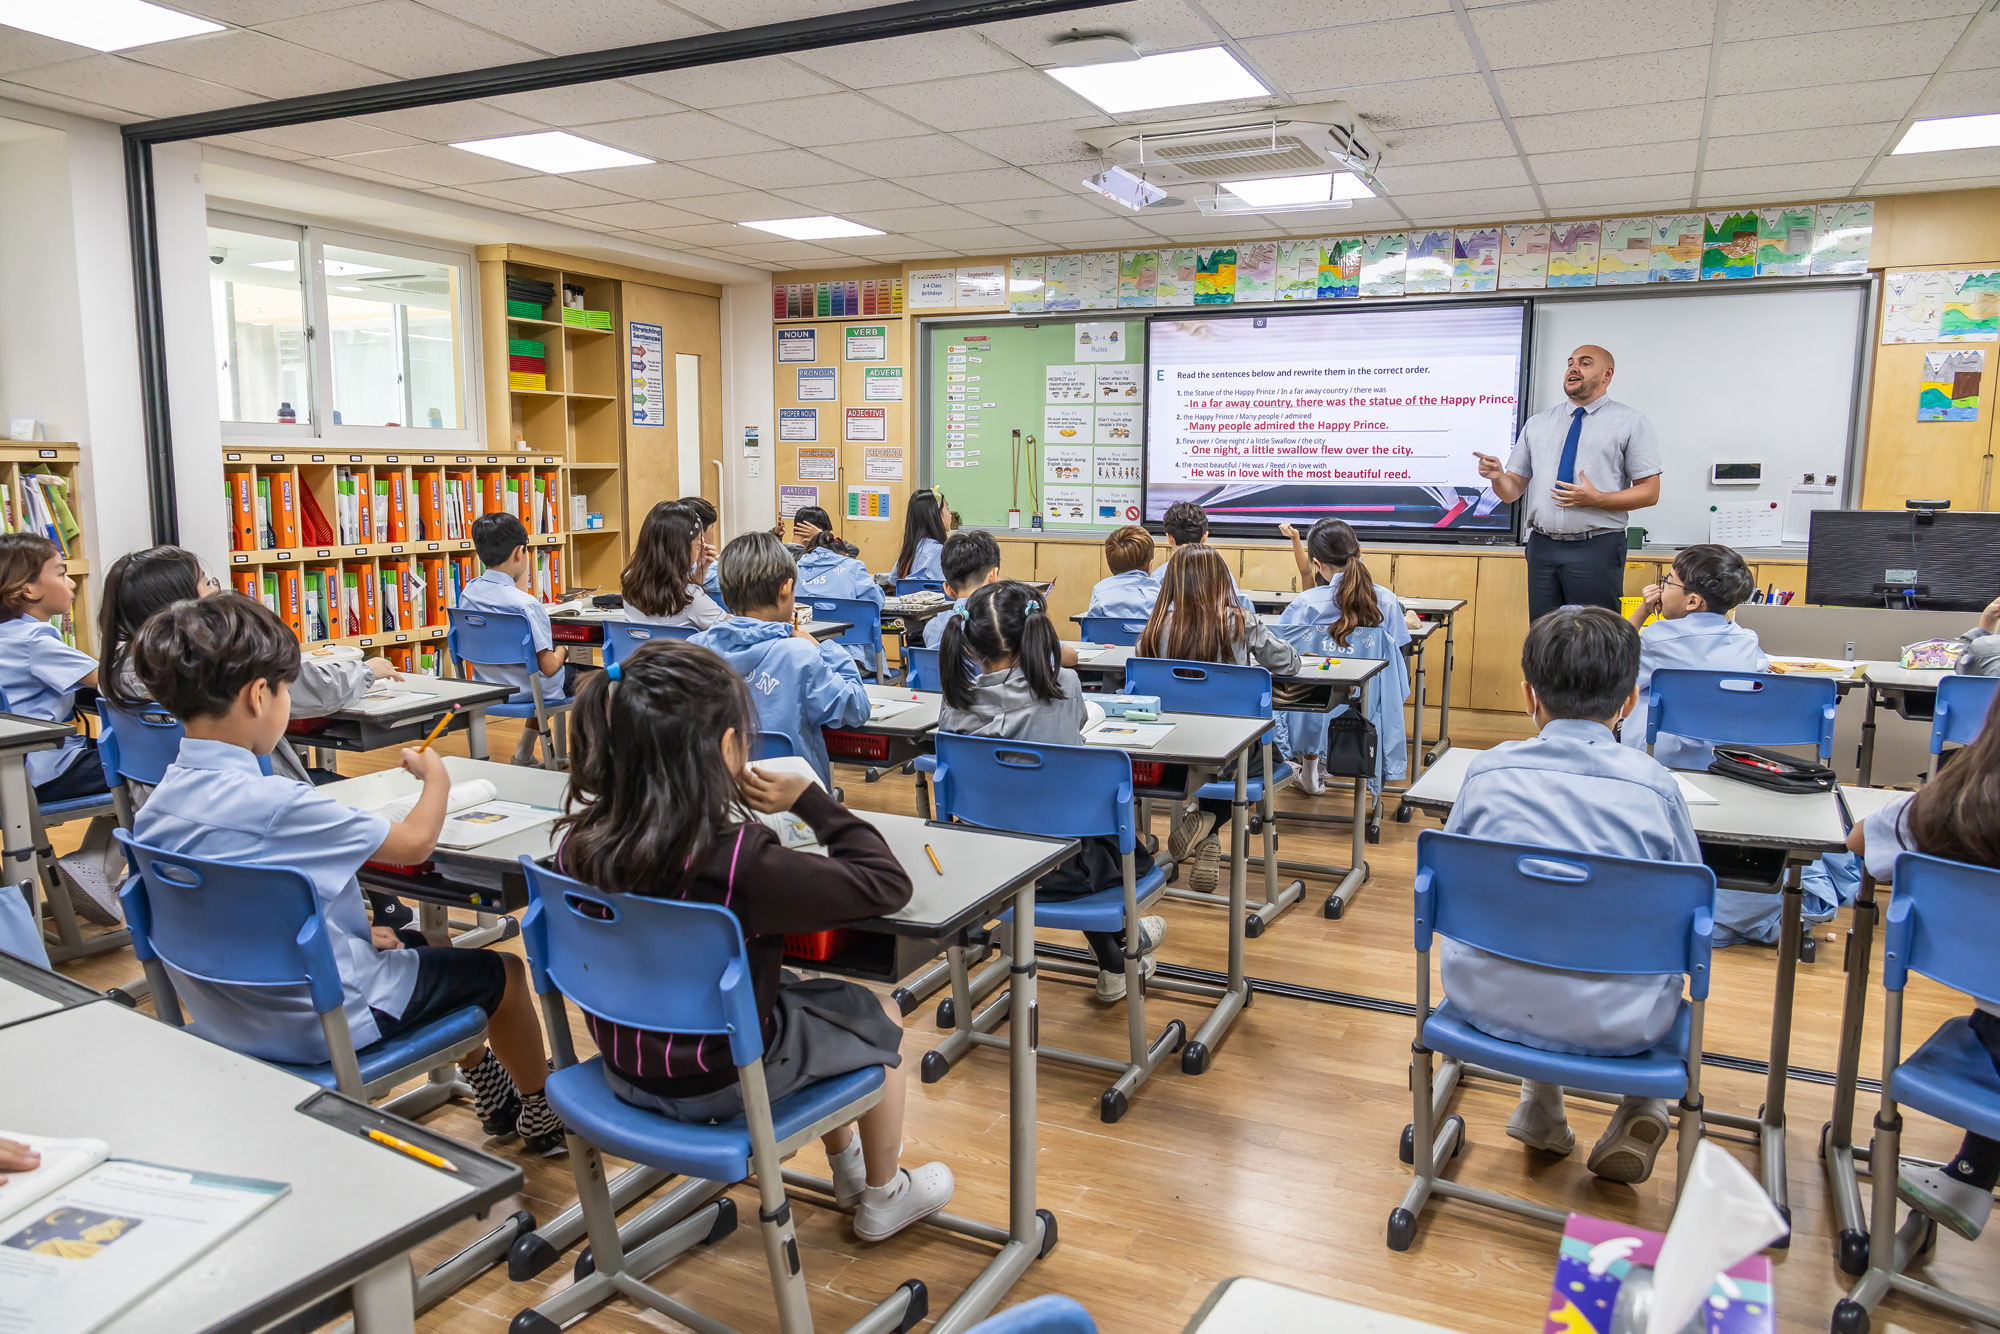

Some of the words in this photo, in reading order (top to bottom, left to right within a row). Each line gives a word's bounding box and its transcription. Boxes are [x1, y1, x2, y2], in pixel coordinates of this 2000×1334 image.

[632, 324, 660, 336] Stretching
[1157, 370, 1164, 381] E
[1210, 399, 1222, 407] far
[1225, 401, 1250, 409] away
[1253, 399, 1293, 408] country,
[1296, 398, 1323, 406] there
[1349, 397, 1366, 406] the
[1369, 397, 1402, 405] statue
[1405, 395, 1417, 405] of
[1419, 395, 1437, 405] the
[1440, 395, 1476, 406] Happy
[1479, 395, 1517, 404] Prince.
[1189, 422, 1216, 432] Many
[1219, 421, 1251, 432] people
[1254, 421, 1295, 430] admired
[1298, 421, 1314, 430] the
[1318, 421, 1350, 432] Happy
[1354, 420, 1389, 429] Prince.
[1192, 446, 1210, 454] One
[1214, 446, 1240, 456] night,
[1252, 445, 1274, 454] little
[1277, 445, 1318, 454] swallow
[1321, 445, 1343, 454] flew
[1372, 445, 1389, 454] the
[1392, 445, 1414, 456] city.
[1192, 469, 1203, 477] He
[1228, 469, 1236, 477] in
[1239, 469, 1259, 477] love
[1262, 469, 1284, 477] with
[1287, 469, 1303, 478] the
[1306, 470, 1331, 478] most
[1334, 469, 1381, 478] beautiful
[1384, 469, 1411, 479] reed.
[1322, 641, 1354, 654] 1965
